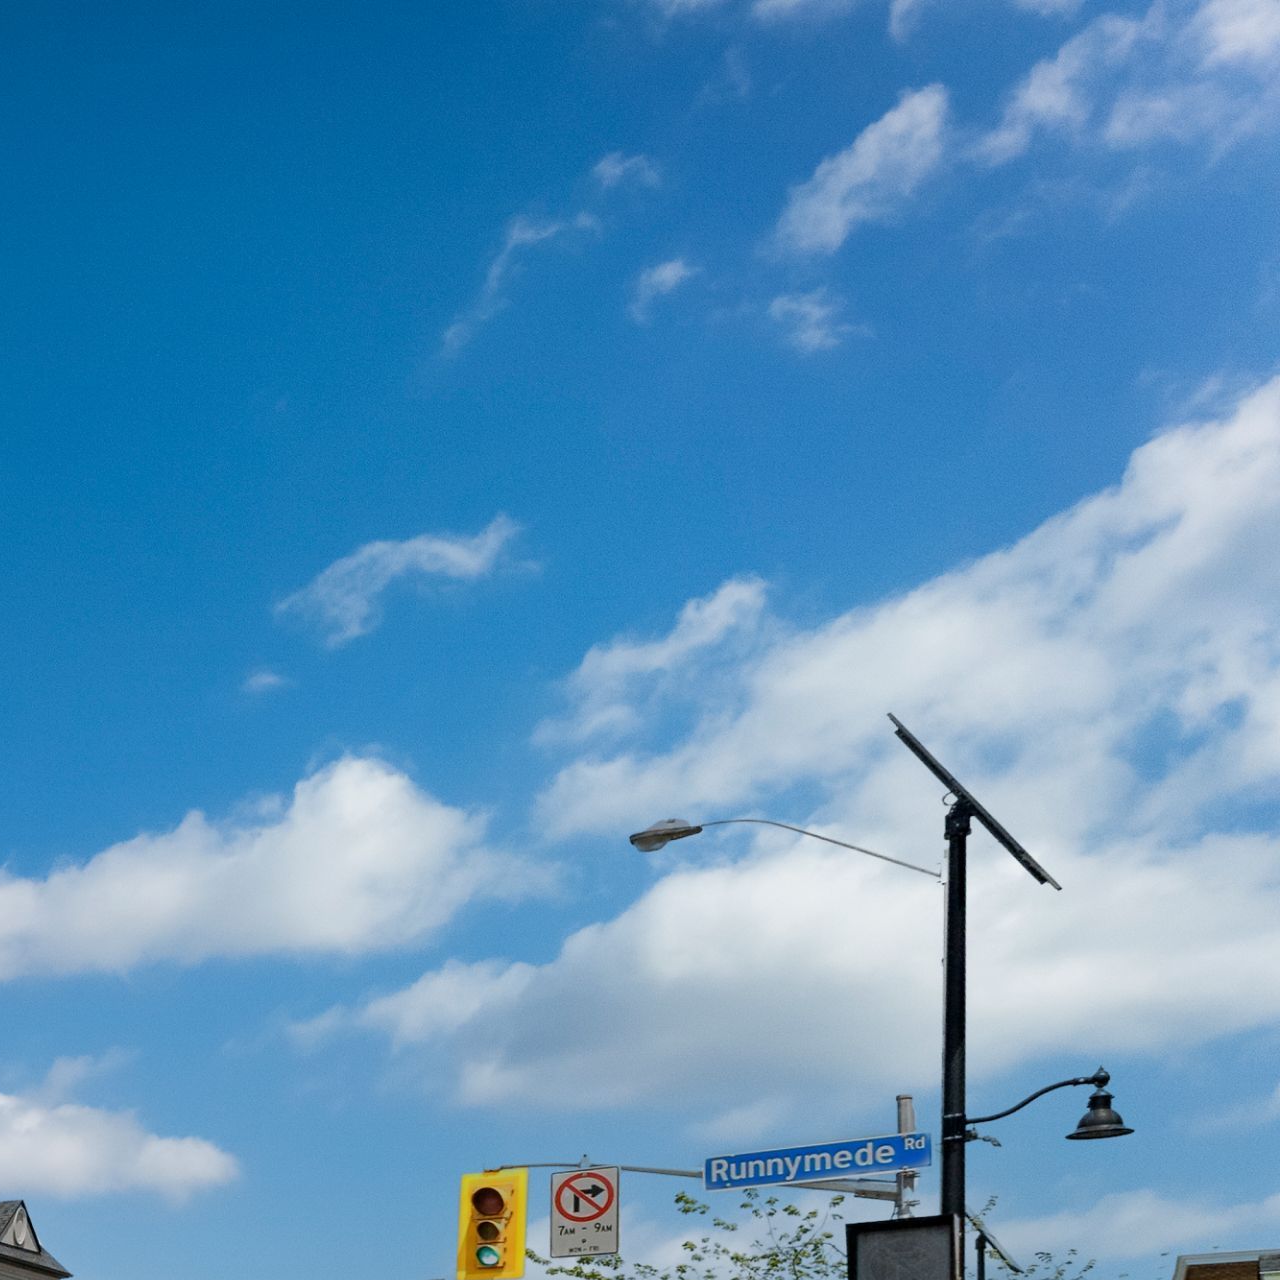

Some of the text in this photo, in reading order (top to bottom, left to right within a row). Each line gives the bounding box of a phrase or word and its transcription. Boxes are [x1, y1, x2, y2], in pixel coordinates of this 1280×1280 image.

[711, 1136, 925, 1182] Runnymede Rd
[558, 1225, 575, 1236] 7AM
[594, 1222, 612, 1232] 9AM
